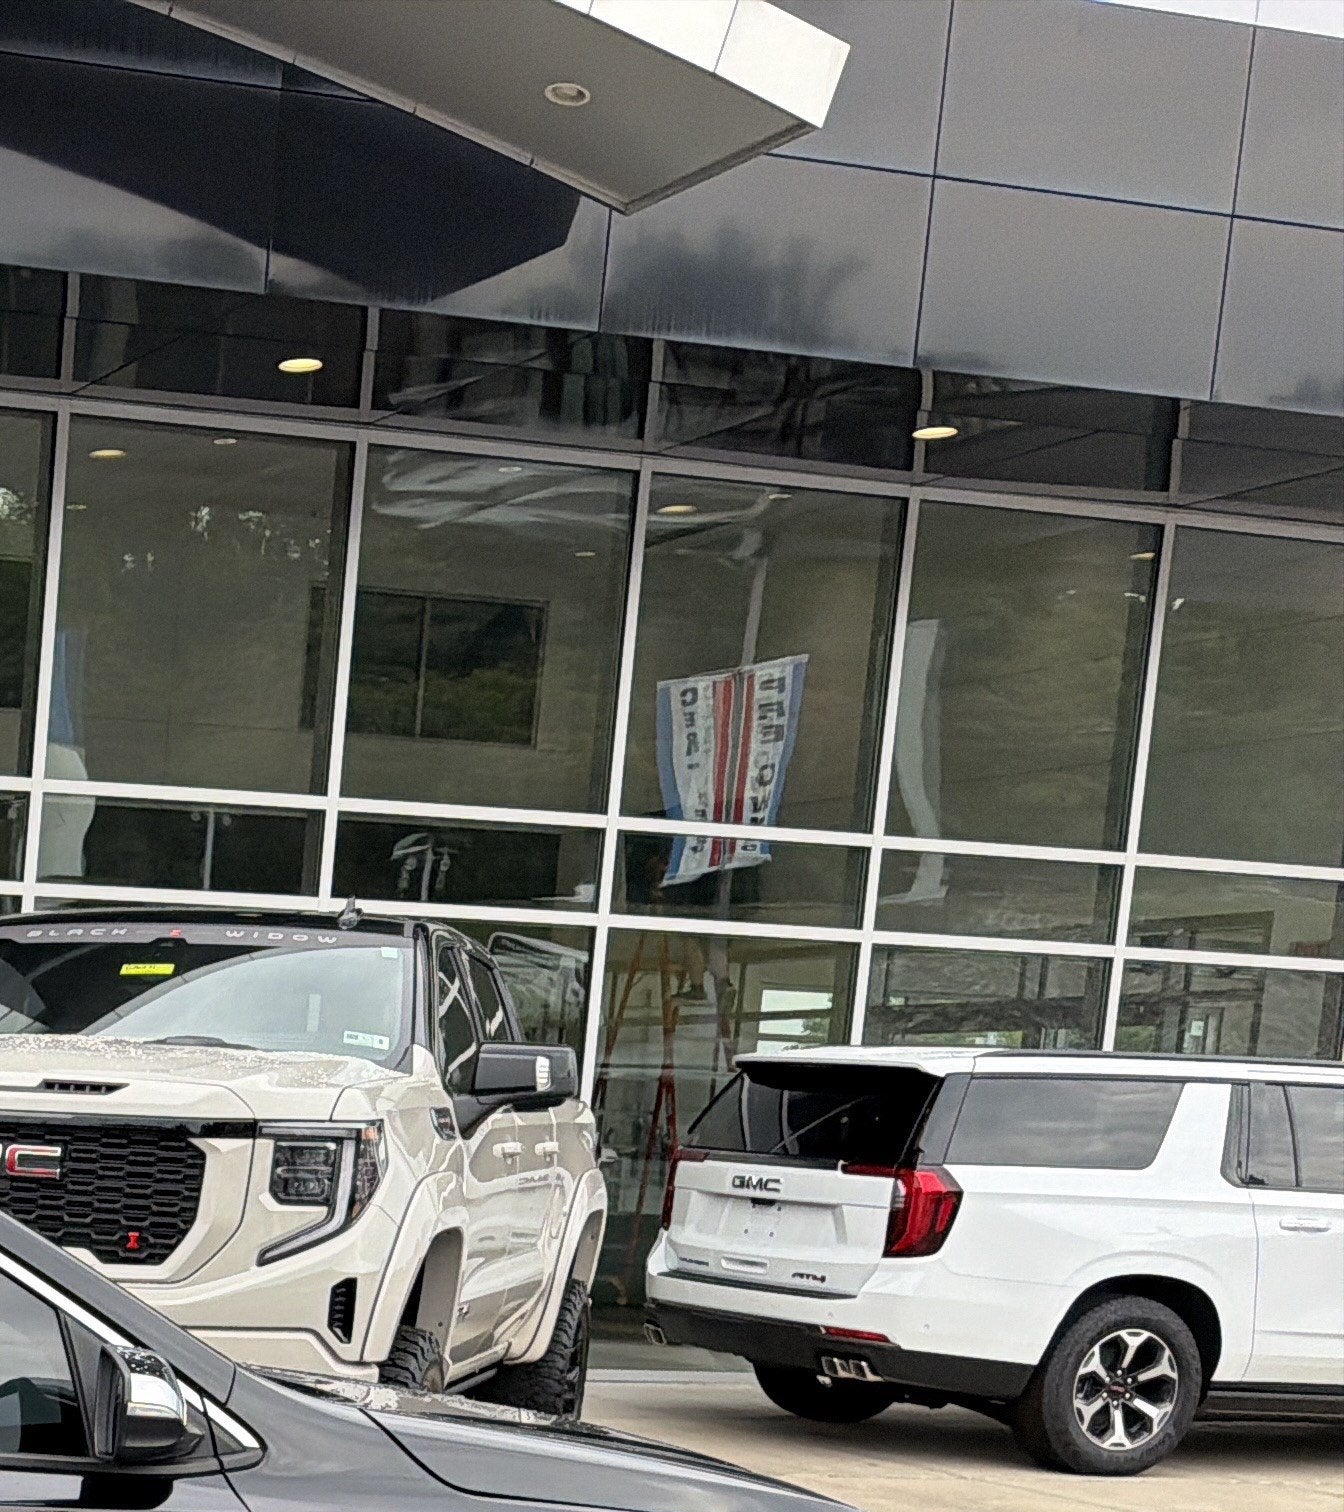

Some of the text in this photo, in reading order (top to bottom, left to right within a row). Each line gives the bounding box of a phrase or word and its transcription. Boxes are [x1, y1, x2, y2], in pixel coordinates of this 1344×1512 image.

[26, 927, 337, 944] BLACK WIDOW
[731, 1175, 782, 1193] GMC
